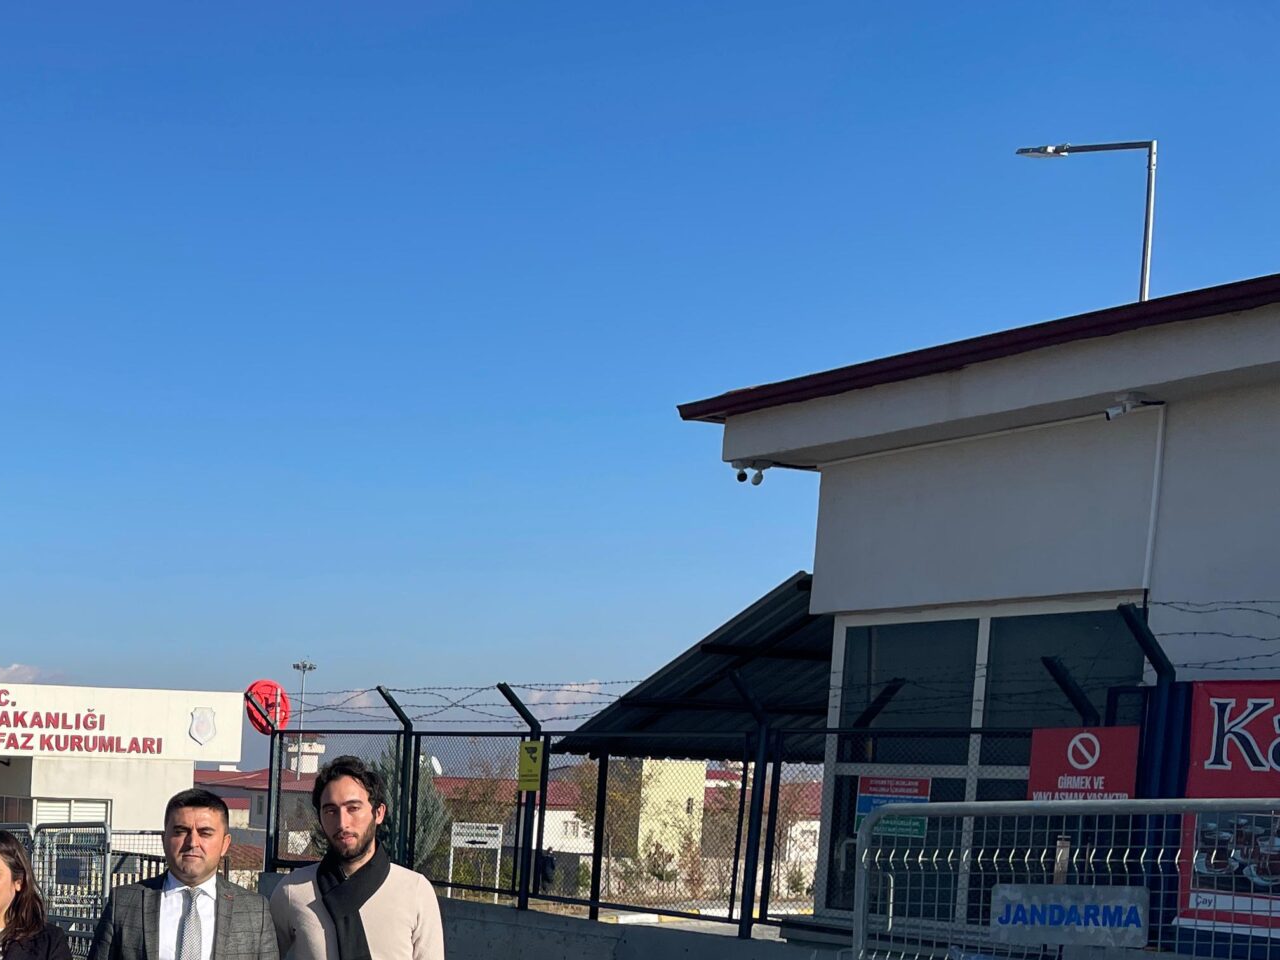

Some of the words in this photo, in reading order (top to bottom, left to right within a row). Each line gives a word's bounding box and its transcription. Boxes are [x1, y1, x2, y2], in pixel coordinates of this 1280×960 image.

[39, 733, 162, 754] KURUMLARI
[1204, 698, 1280, 771] K
[1058, 773, 1092, 789] GİRMEK
[1093, 776, 1105, 790] VE
[998, 903, 1142, 928] JANDARMA
